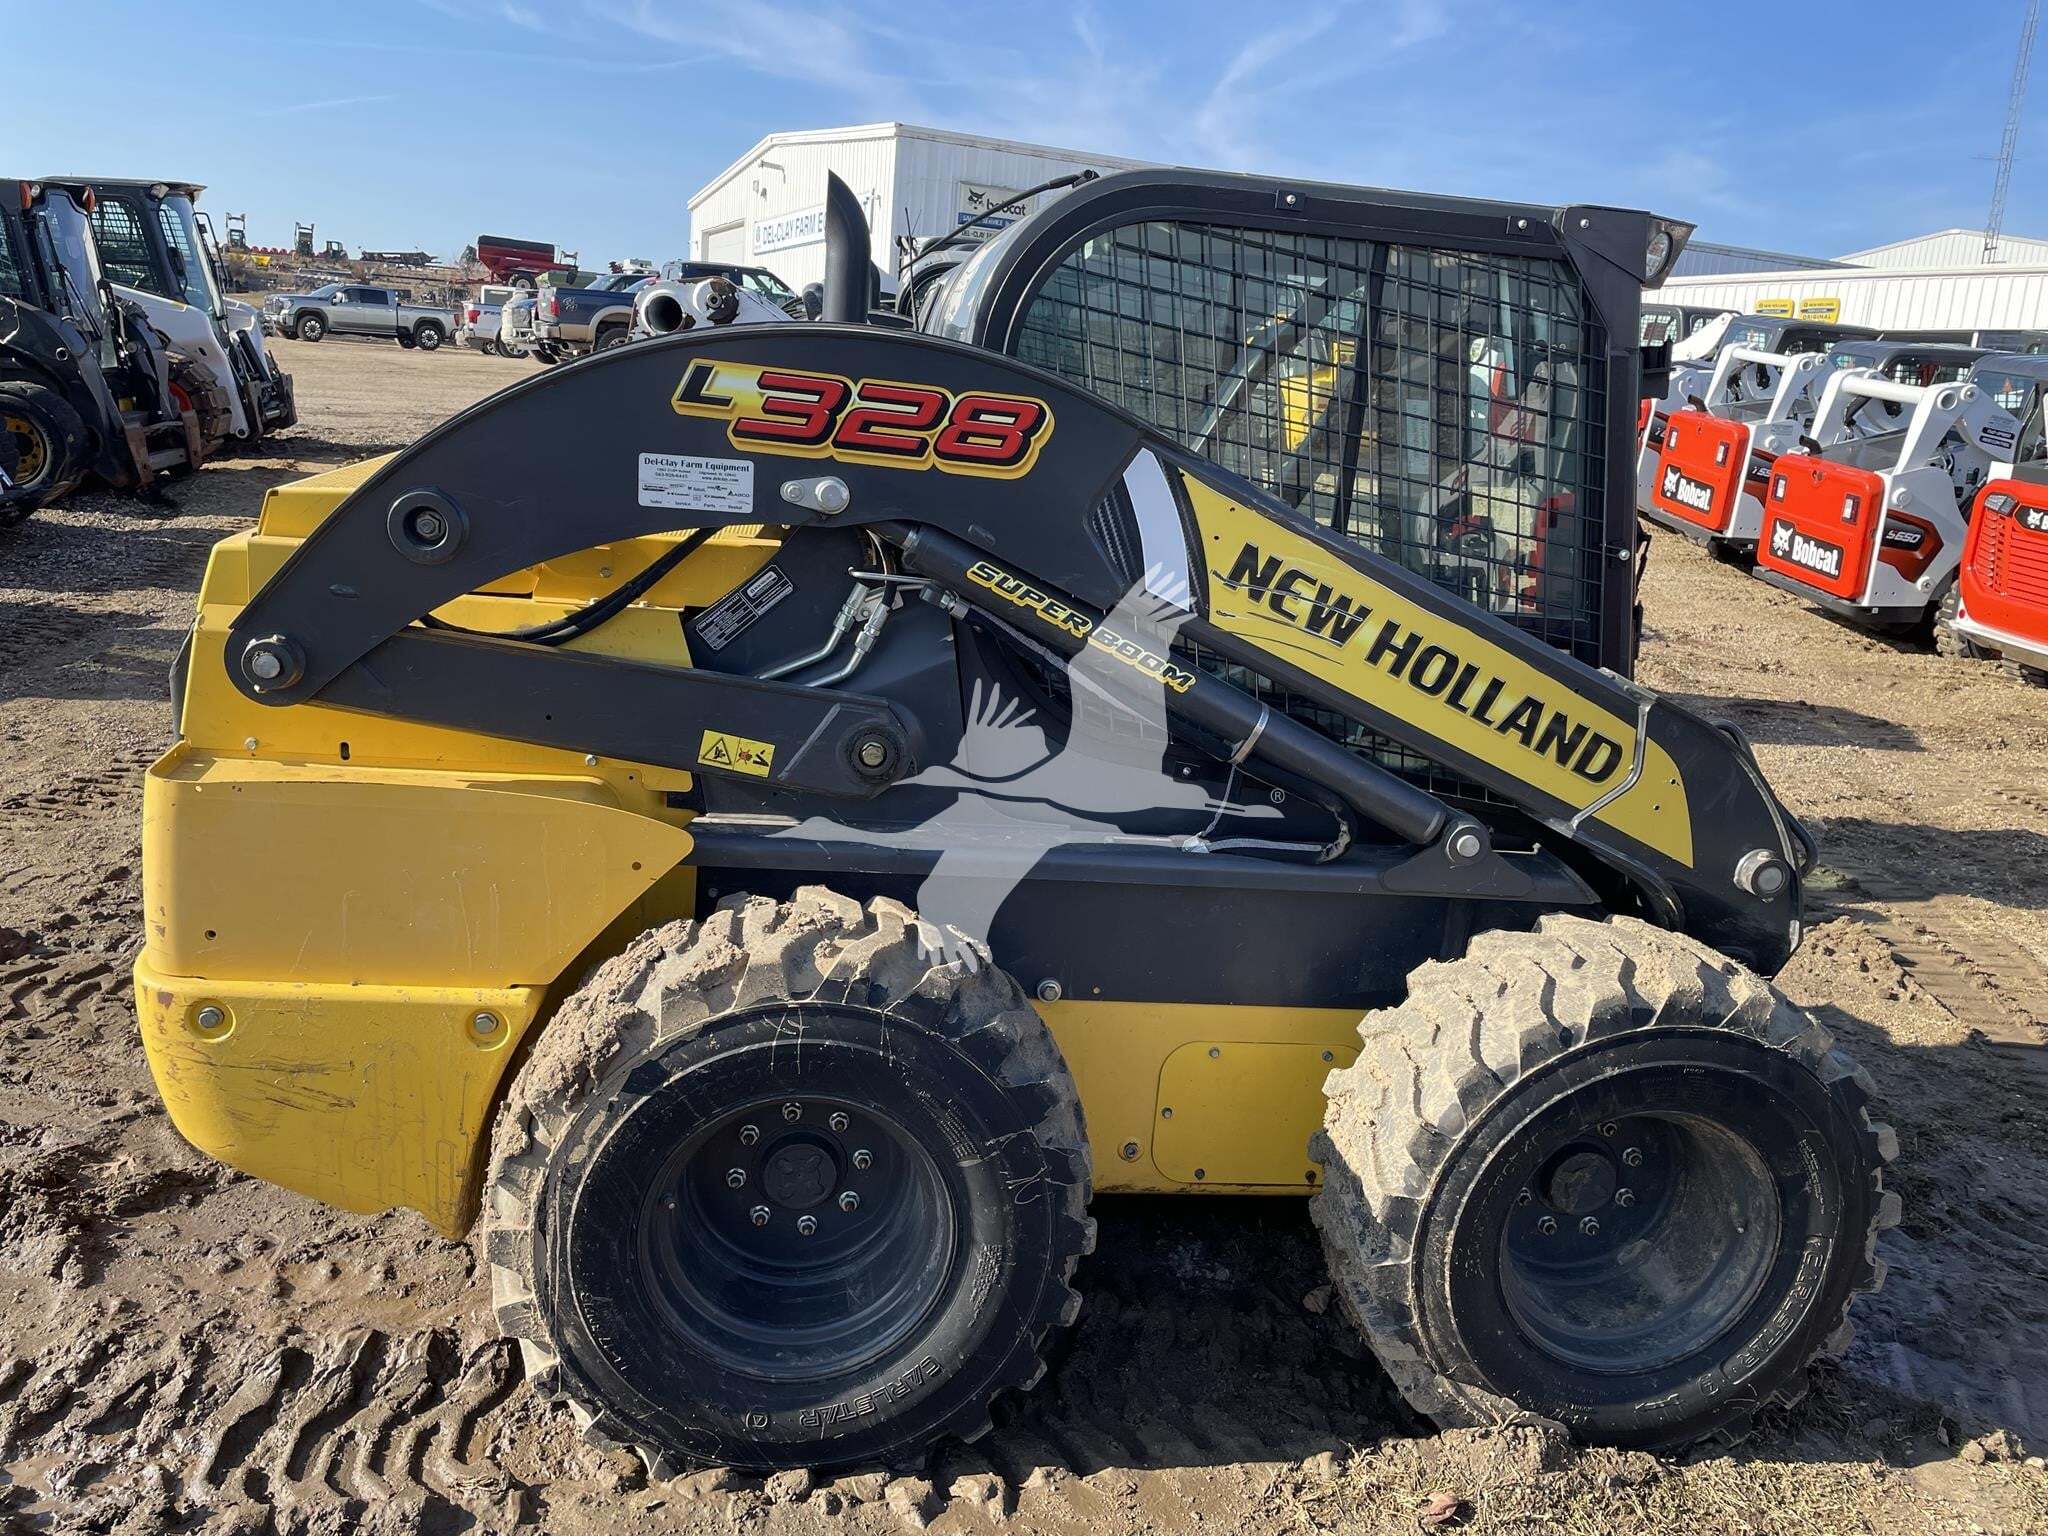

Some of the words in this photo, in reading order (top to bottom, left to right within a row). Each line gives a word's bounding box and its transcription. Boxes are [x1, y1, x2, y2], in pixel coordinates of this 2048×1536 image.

[762, 219, 794, 245] DEL-CLAY
[796, 213, 816, 238] FARM
[644, 457, 679, 468] Del-Clay
[681, 460, 703, 469] Farm
[705, 462, 750, 472] Equipment
[672, 358, 1056, 478] L328
[966, 561, 1093, 638] SUPER
[1087, 626, 1197, 693] BOOM
[1225, 542, 1374, 649] NEW
[1364, 618, 1624, 784] HOLLAND
[799, 1355, 944, 1427] CARLSTAR
